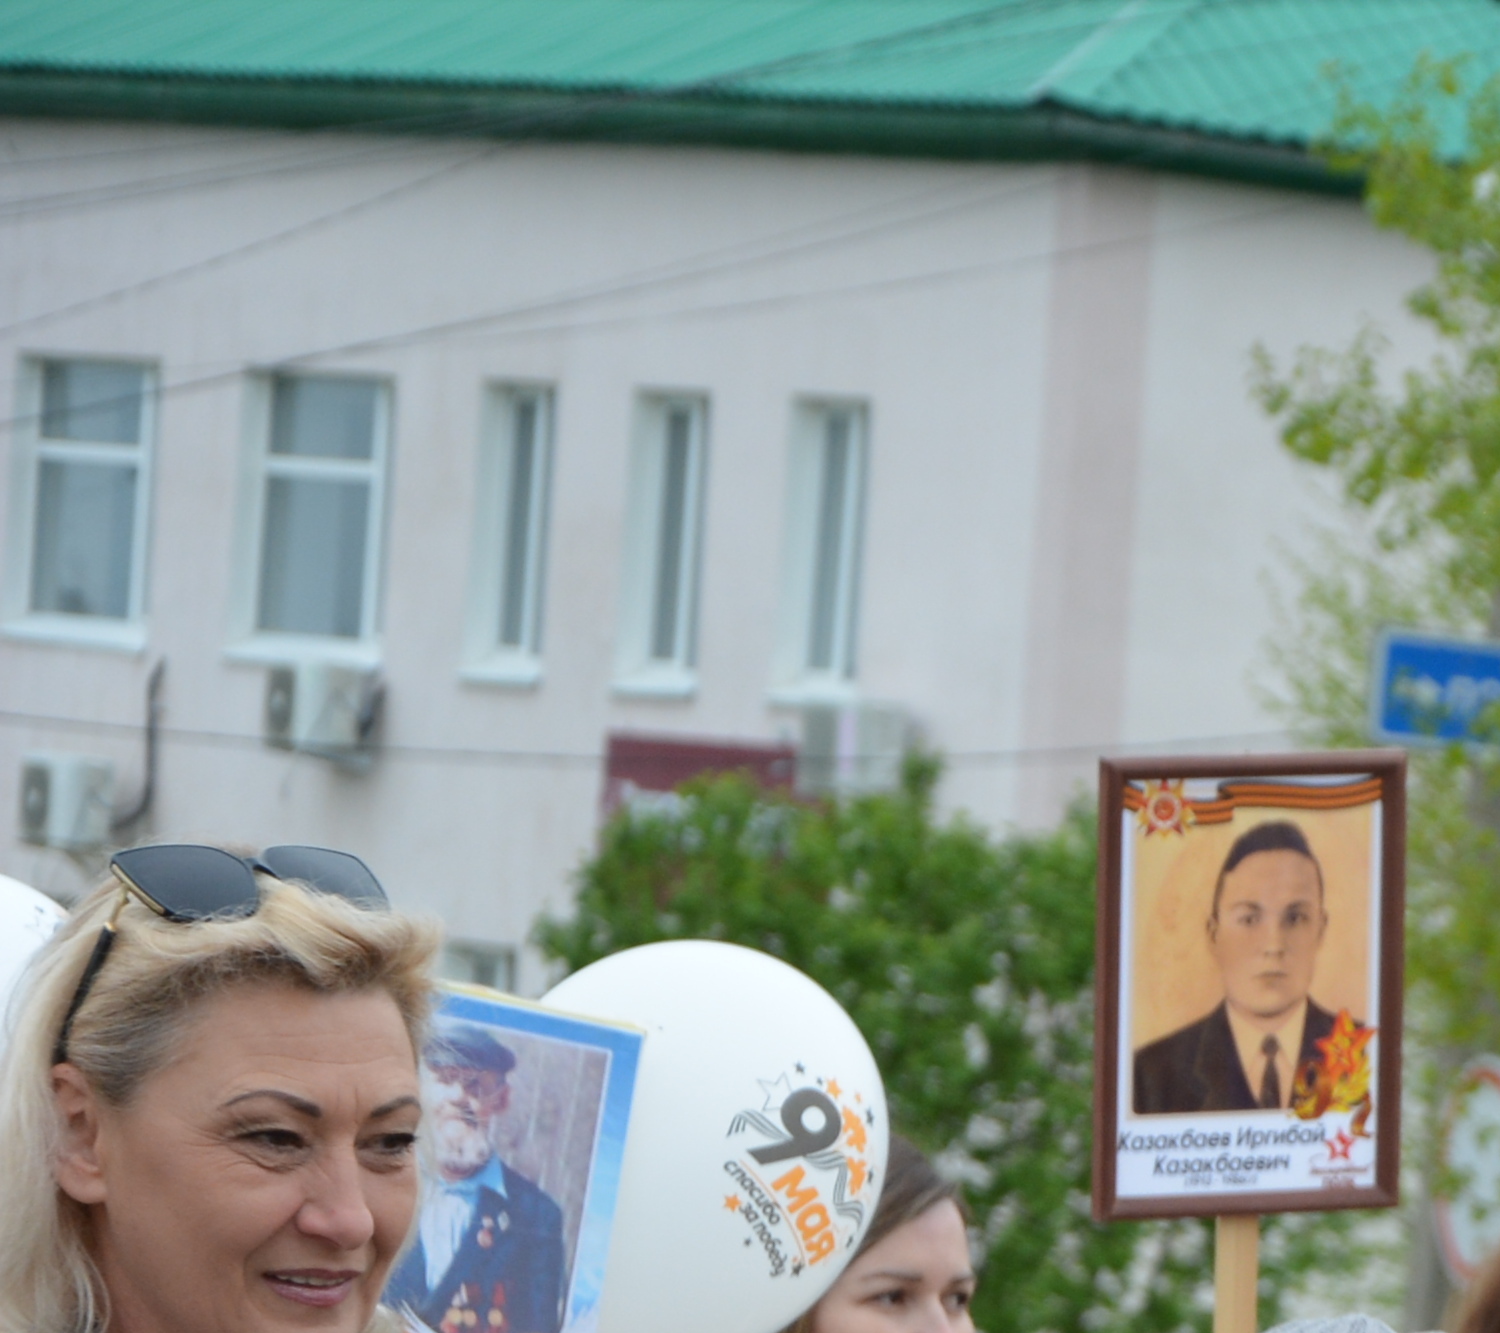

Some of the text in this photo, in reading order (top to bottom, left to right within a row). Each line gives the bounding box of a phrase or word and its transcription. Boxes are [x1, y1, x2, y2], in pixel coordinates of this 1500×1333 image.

[746, 1087, 842, 1165] 9
[1119, 1123, 1326, 1151] Казакбаев Иргибай
[723, 1160, 781, 1226] спасибо
[1153, 1153, 1291, 1176] Казакбаевич
[739, 1202, 787, 1277] за победу
